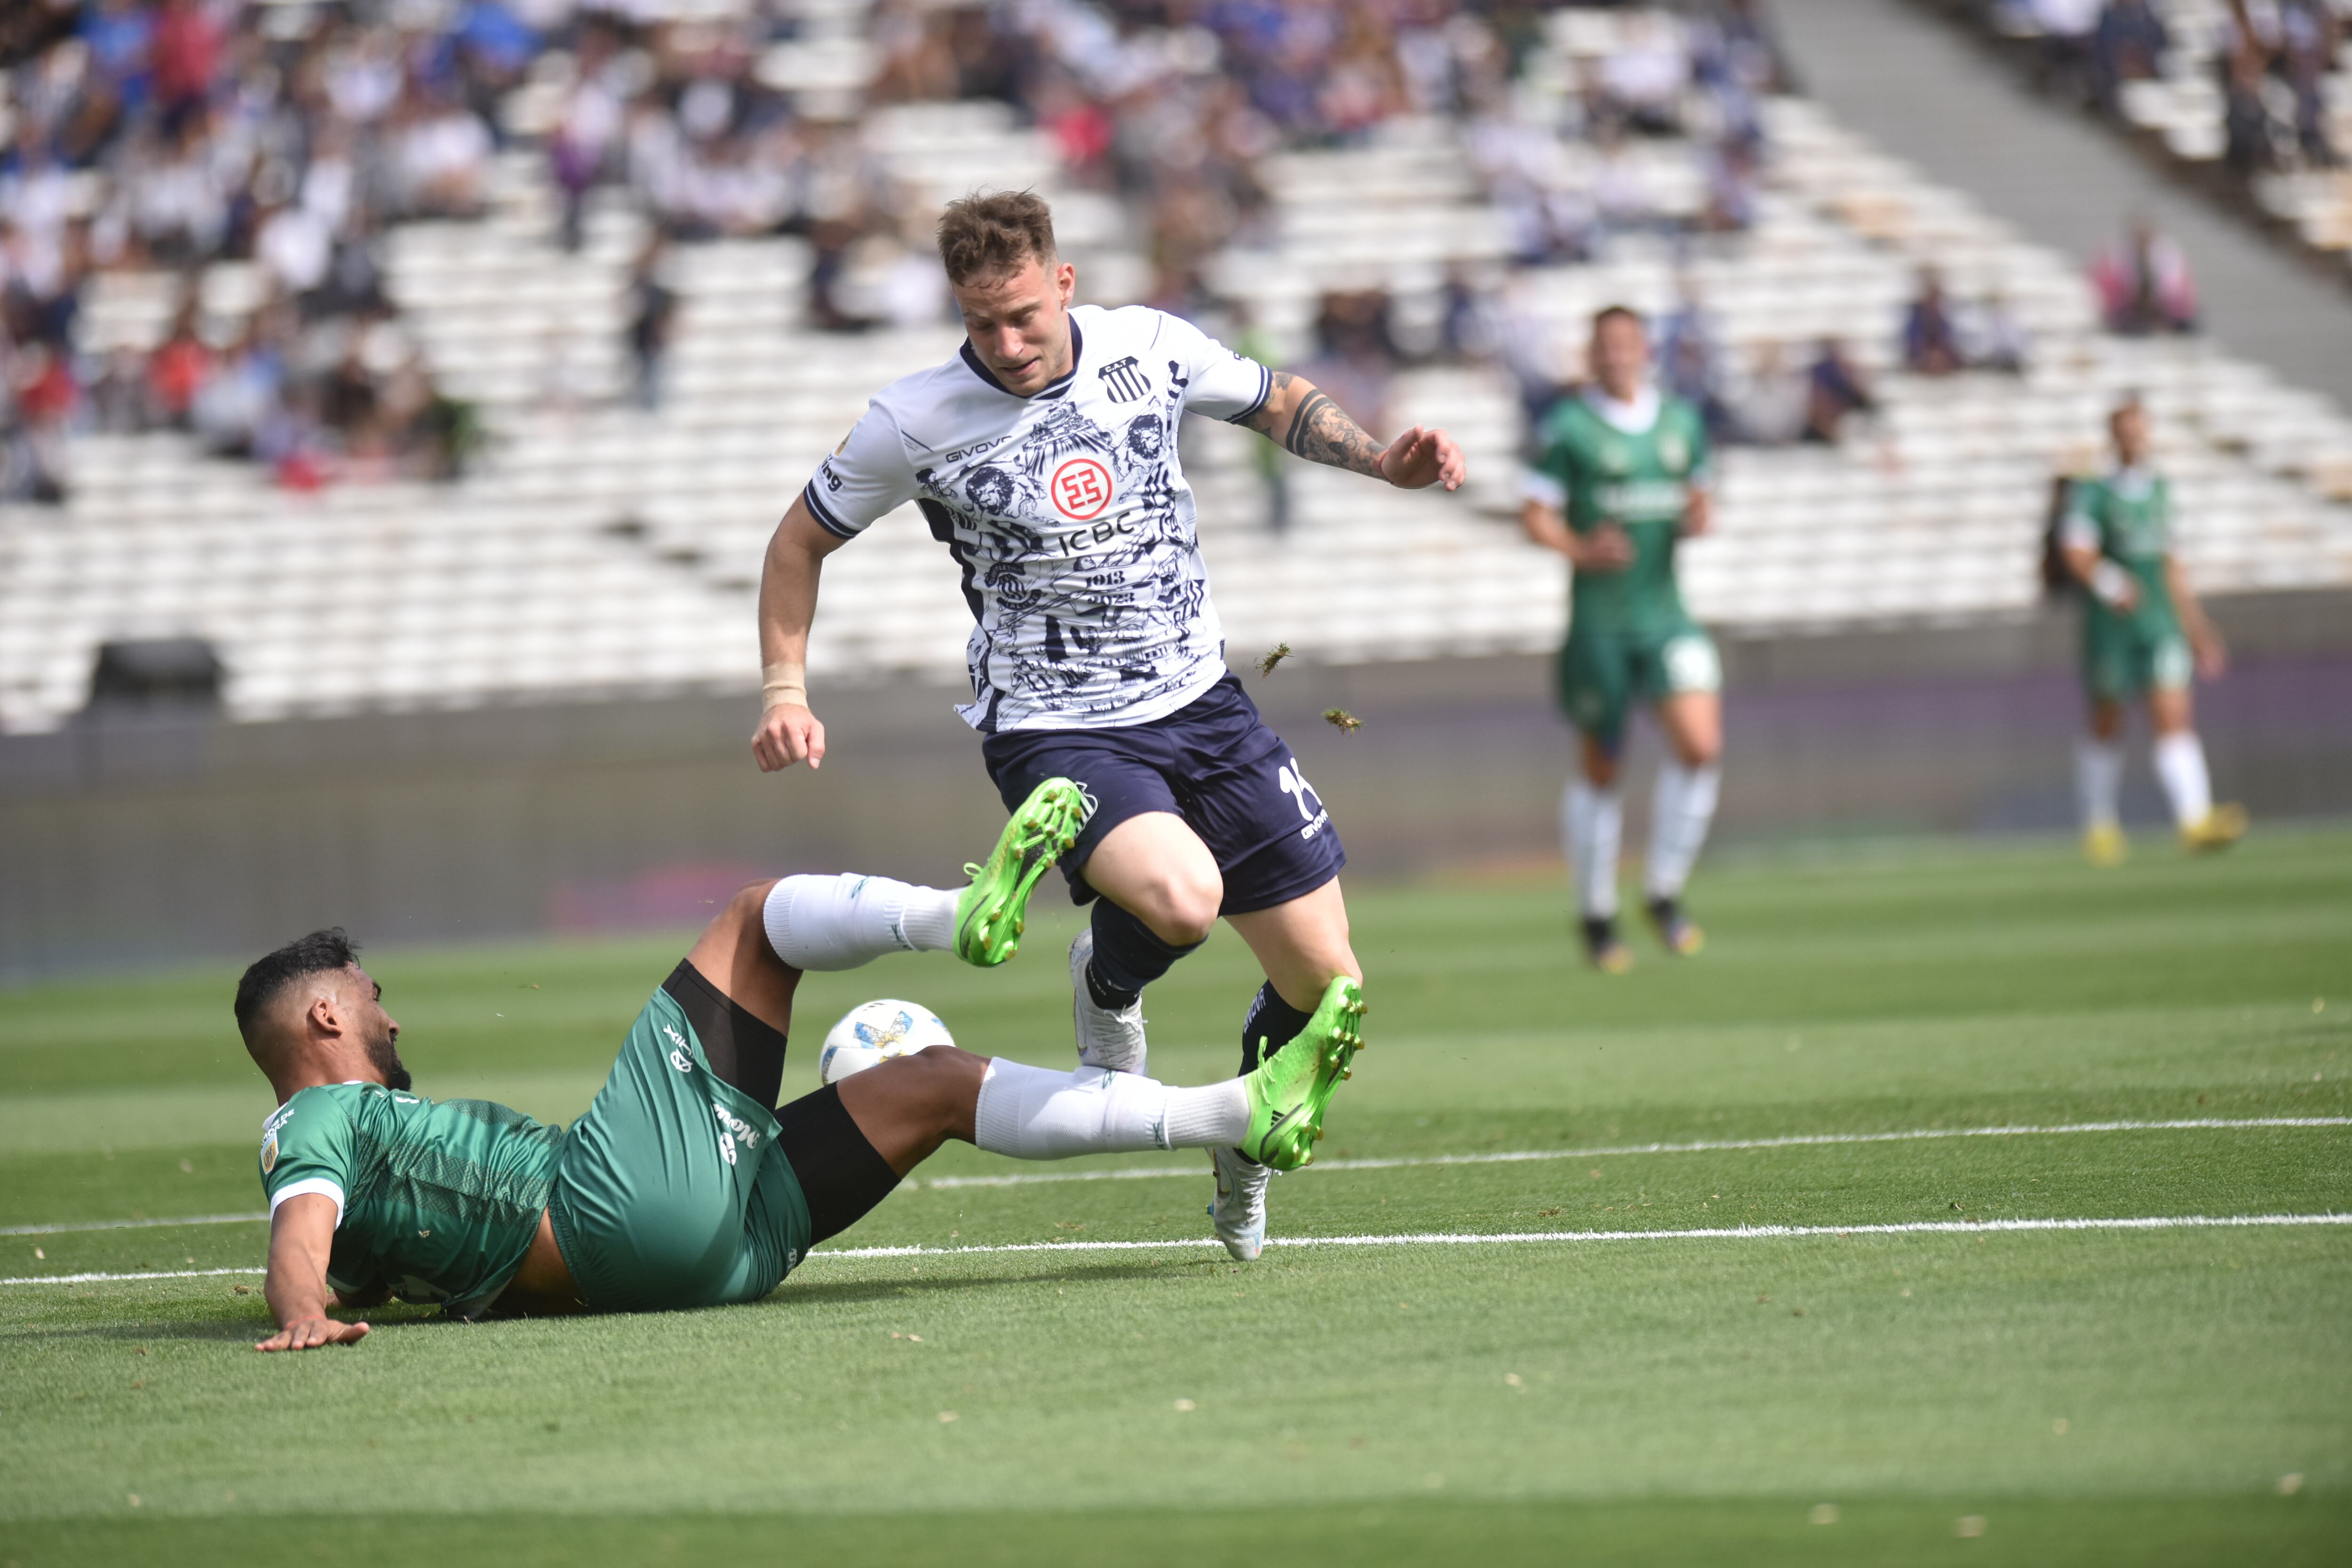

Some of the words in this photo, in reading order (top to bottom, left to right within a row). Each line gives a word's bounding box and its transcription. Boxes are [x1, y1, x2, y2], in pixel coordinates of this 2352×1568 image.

[1058, 511, 1135, 557] ICBC
[1086, 571, 1125, 588] 1913
[1088, 592, 1136, 605] 2023
